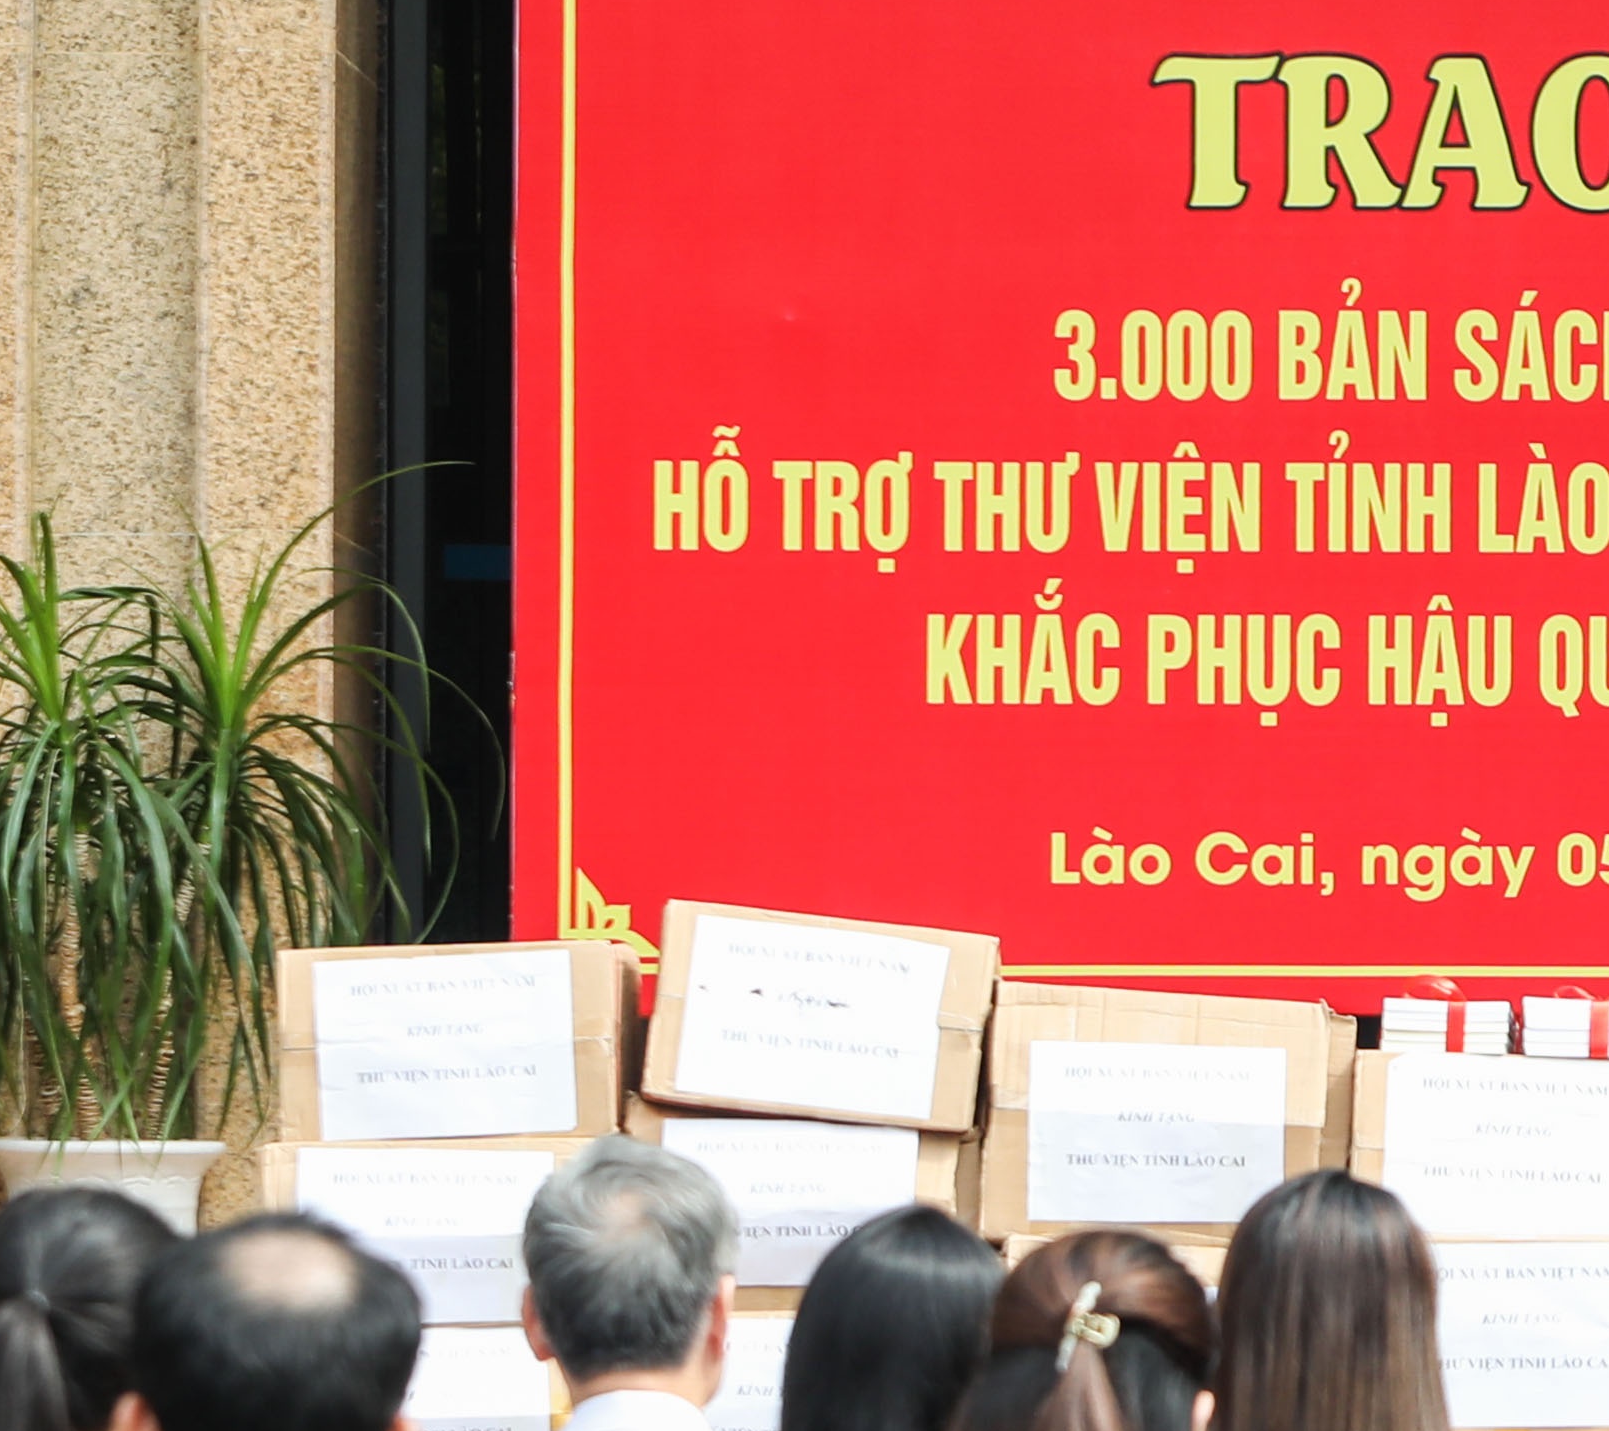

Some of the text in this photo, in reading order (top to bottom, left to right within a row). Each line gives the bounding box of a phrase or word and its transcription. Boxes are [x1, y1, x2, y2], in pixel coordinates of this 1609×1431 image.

[1055, 310, 1252, 401] 3.000
[1279, 278, 1427, 400] BẢN
[654, 426, 749, 552] HỖ
[773, 451, 913, 573] TRỢ
[934, 451, 1080, 553] THƯ
[1095, 442, 1261, 574] VIỆN
[1285, 430, 1451, 553] TỈNH
[927, 578, 1120, 706] KHẮC
[1147, 613, 1341, 726] PHỤC
[1368, 595, 1512, 727] HẬU
[1051, 827, 1171, 885] Lào
[1195, 831, 1334, 896] Cai,
[1362, 828, 1534, 902] ngày
[1218, 1154, 1246, 1168] CAI
[486, 1256, 514, 1270] CAI
